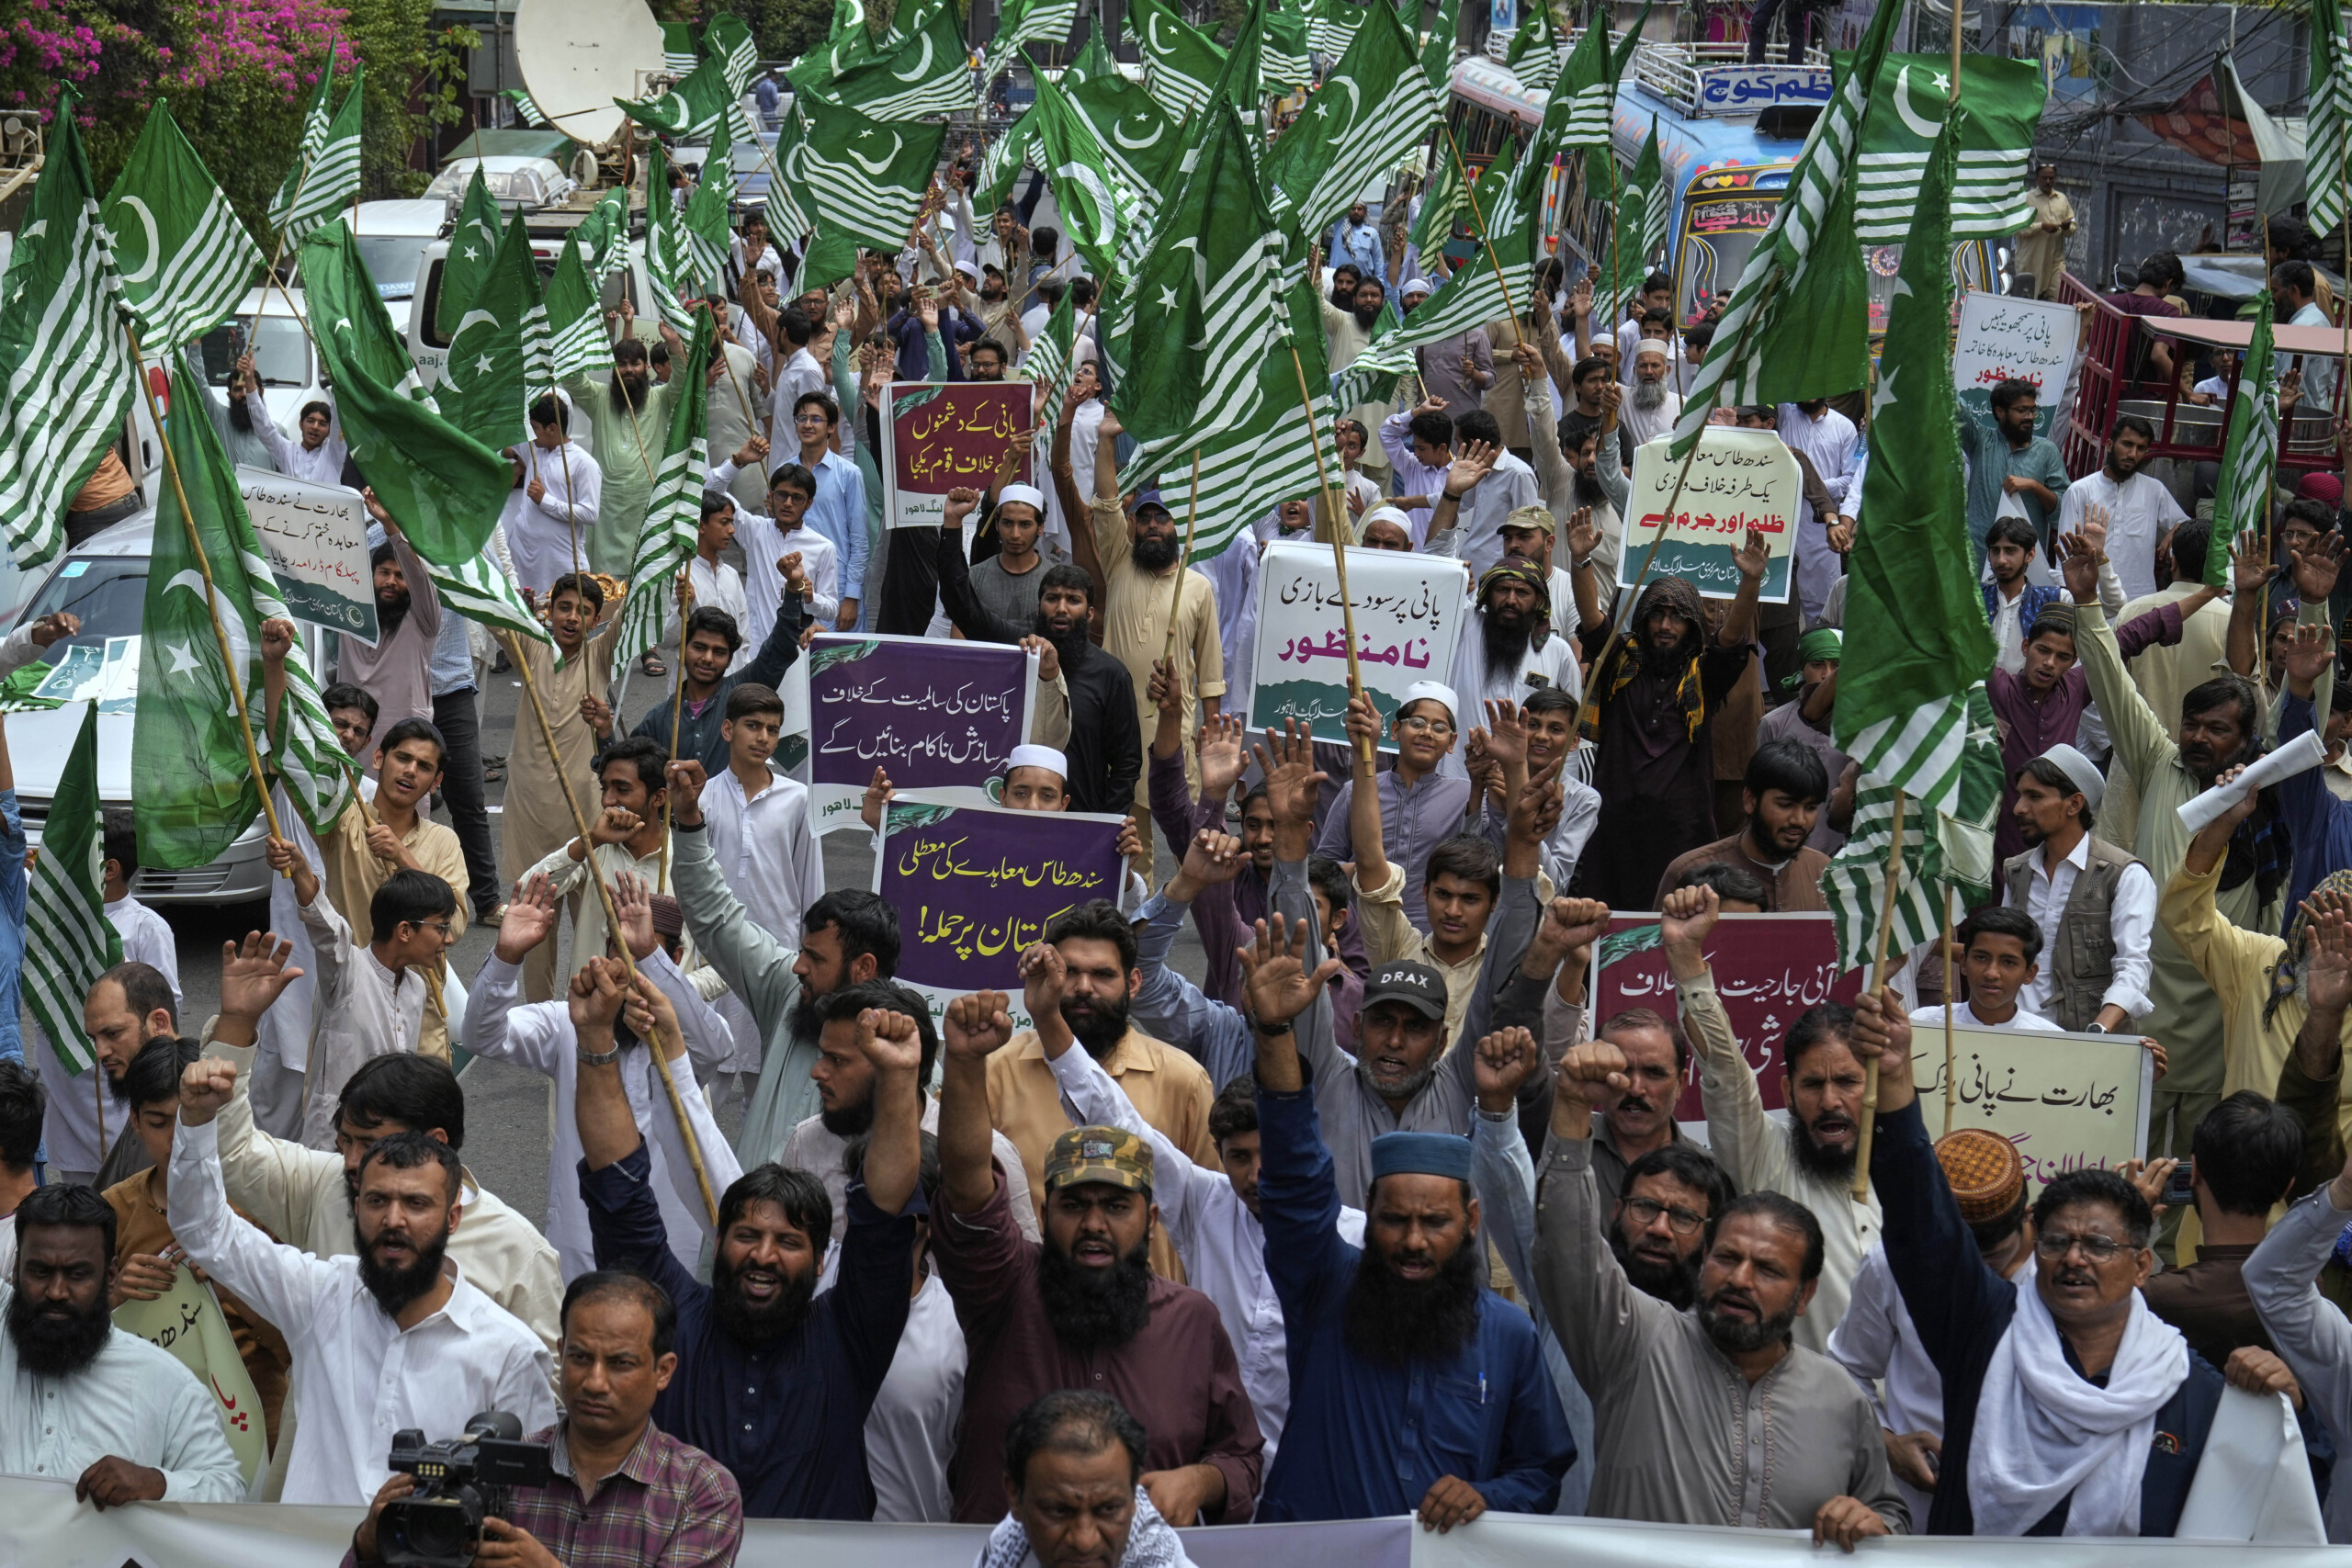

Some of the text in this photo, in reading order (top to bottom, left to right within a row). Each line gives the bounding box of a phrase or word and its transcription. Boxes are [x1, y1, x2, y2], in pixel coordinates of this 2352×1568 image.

[378, 282, 415, 291] DAW
[2023, 326, 2033, 343] پر
[2034, 315, 2051, 348] پانی
[1963, 339, 1985, 355] خاتمہ
[1986, 343, 1996, 356] کا
[2017, 349, 2039, 364] طاس
[419, 355, 443, 368] aaj.
[2039, 355, 2064, 366] سندھ
[966, 400, 993, 432] کے
[930, 446, 954, 484] قوم
[956, 455, 993, 474] خلاف
[1713, 449, 1743, 467] طاس
[1743, 456, 1774, 467] سندھ
[1690, 477, 1725, 493] خلاف
[1723, 474, 1753, 499] طرفہ
[242, 486, 349, 521] بھارت نے سندھ طاس
[264, 516, 280, 533] کے
[1676, 511, 1716, 532] جرم
[1716, 512, 1745, 534] اور
[315, 523, 329, 549] ختم
[328, 535, 358, 550] معاہدہ
[1280, 576, 1324, 612] بازی
[1410, 581, 1441, 631] پانی
[1389, 596, 1407, 625] پر
[821, 677, 1017, 723] پاکستان کی سالمیت کے خلاف
[820, 716, 856, 753] گے
[948, 726, 1001, 764] سازش
[933, 836, 968, 880] کی
[953, 856, 1023, 888] معاہدے
[1022, 860, 1066, 887] طاس
[1064, 872, 1104, 888] سندھ
[1380, 971, 1429, 988] DRAX
[1721, 967, 1802, 1006] جارحیت
[1960, 1054, 1996, 1117] پانی
[1996, 1067, 2038, 1102] نے
[2041, 1081, 2119, 1116] بھارت
